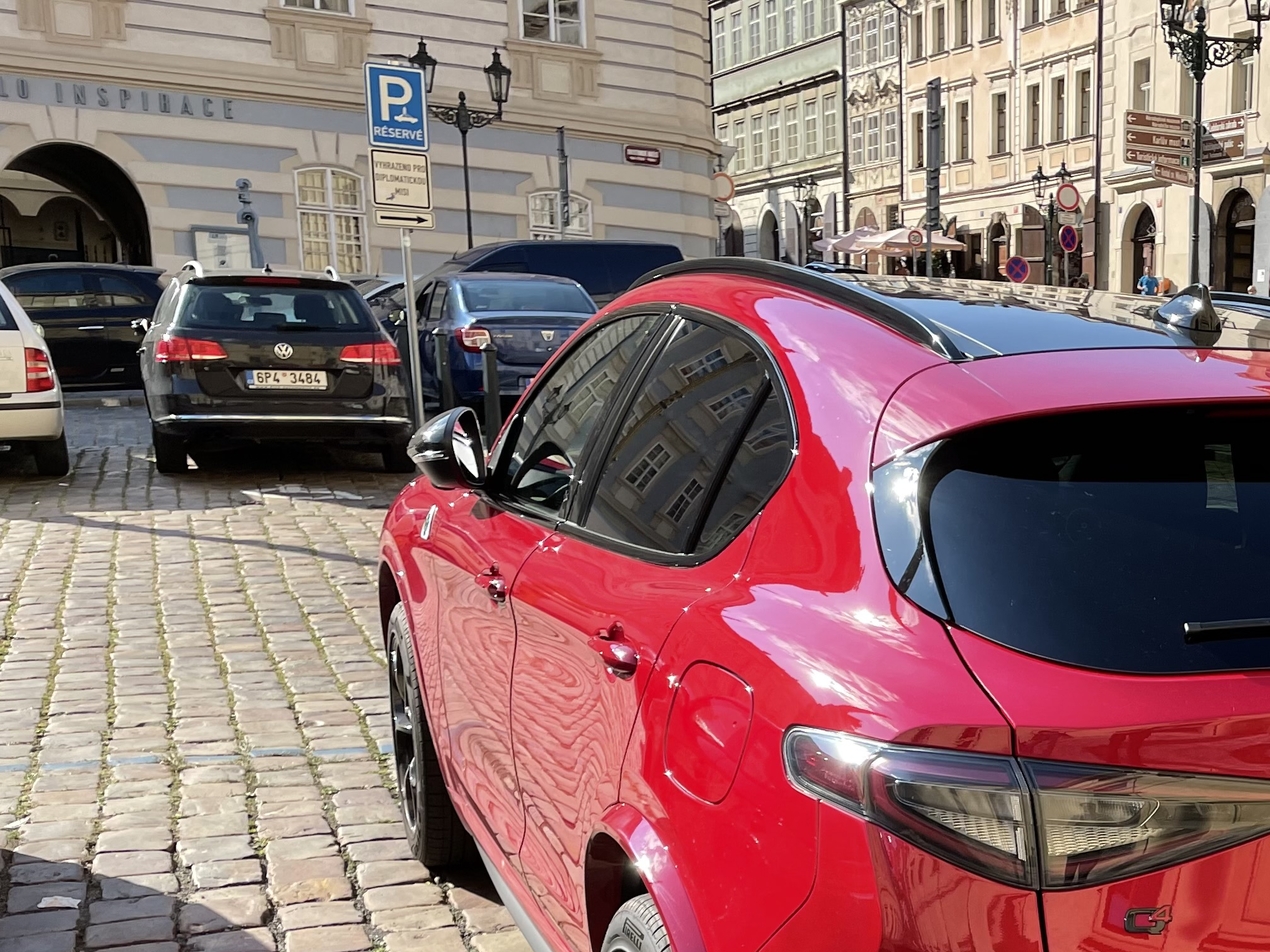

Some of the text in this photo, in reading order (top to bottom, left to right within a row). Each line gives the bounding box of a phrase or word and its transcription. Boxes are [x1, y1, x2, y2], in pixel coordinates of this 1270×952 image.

[54, 82, 235, 120] INSPIRACE
[378, 74, 413, 122] P
[373, 125, 424, 141] RÉSERVÉ
[256, 371, 321, 384] 6P4 3484
[621, 916, 645, 951] PIRELLI
